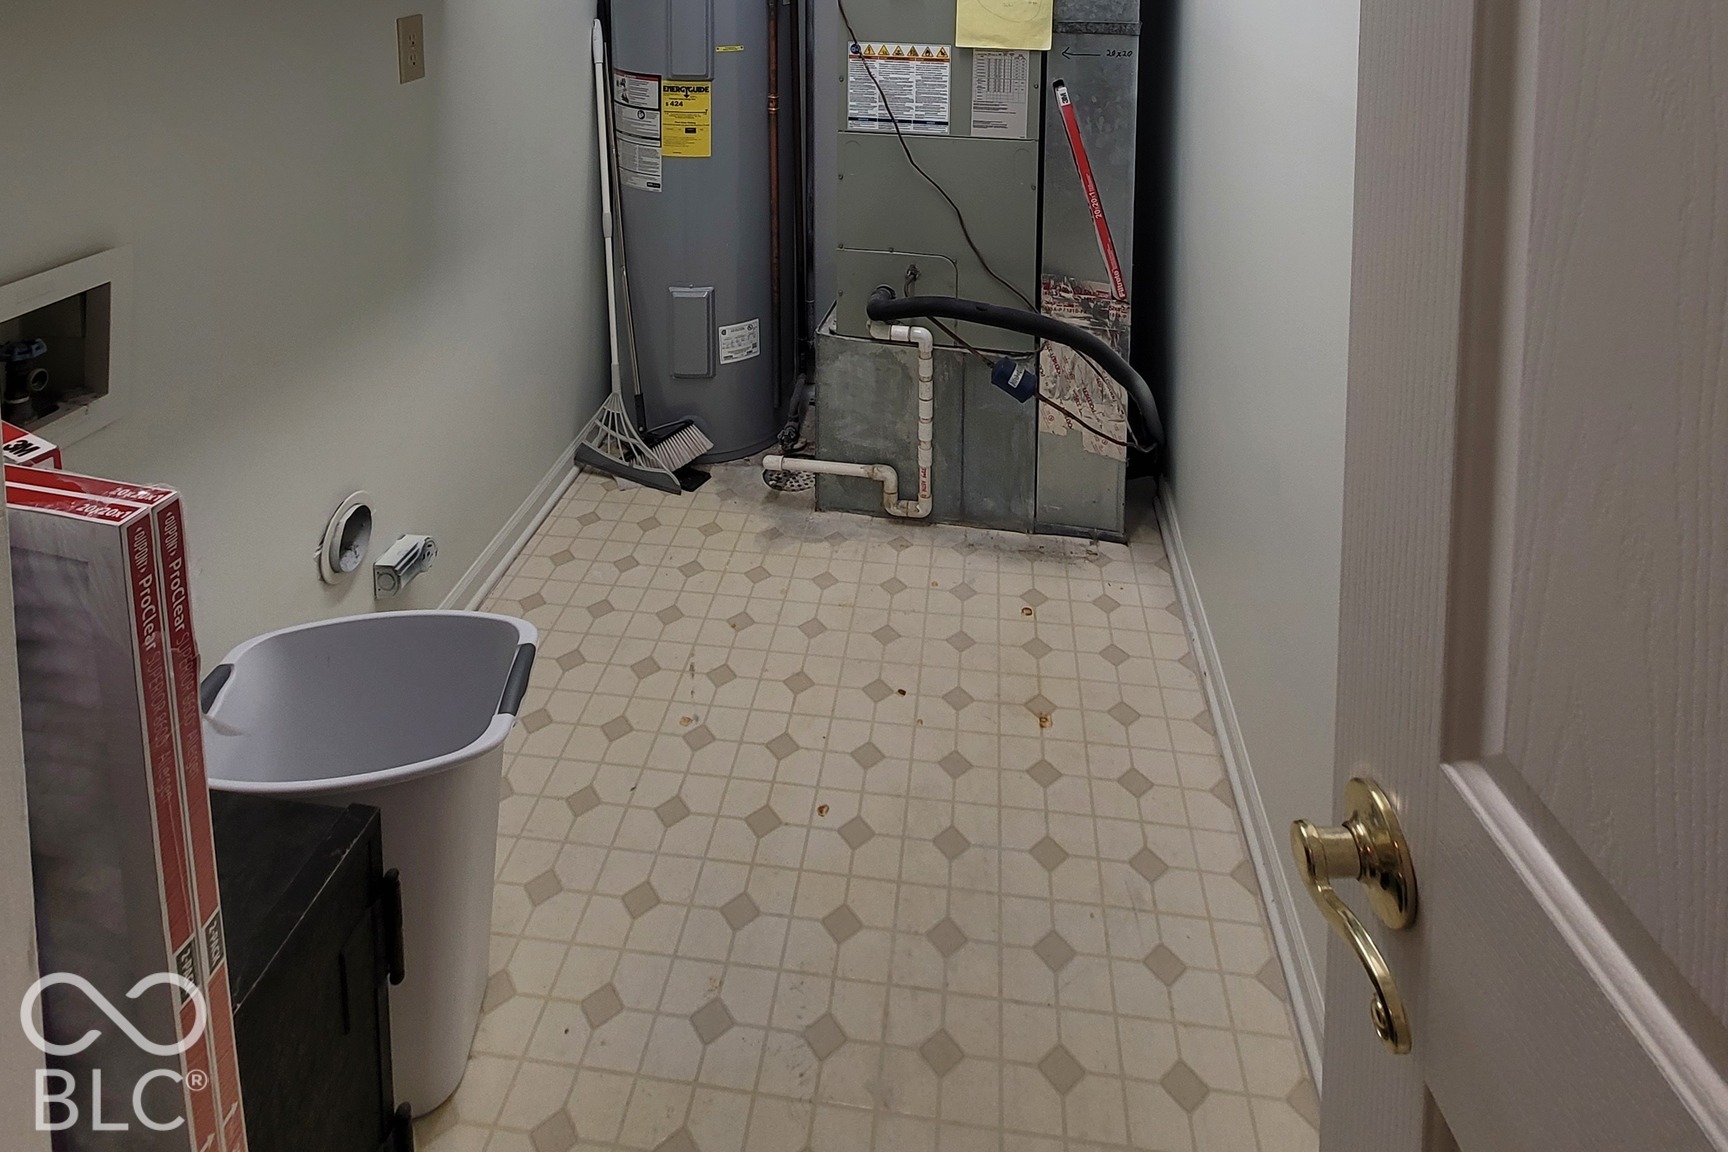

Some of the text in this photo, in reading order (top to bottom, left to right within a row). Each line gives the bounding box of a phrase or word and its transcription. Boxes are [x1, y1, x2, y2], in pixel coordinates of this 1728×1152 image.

[3, 440, 41, 457] 3M
[76, 503, 132, 519] 20x20x1
[139, 573, 157, 651] ProClear
[169, 557, 185, 631] ProClear
[147, 650, 168, 715] SUPERIOR
[176, 632, 196, 695] SUPERIOR
